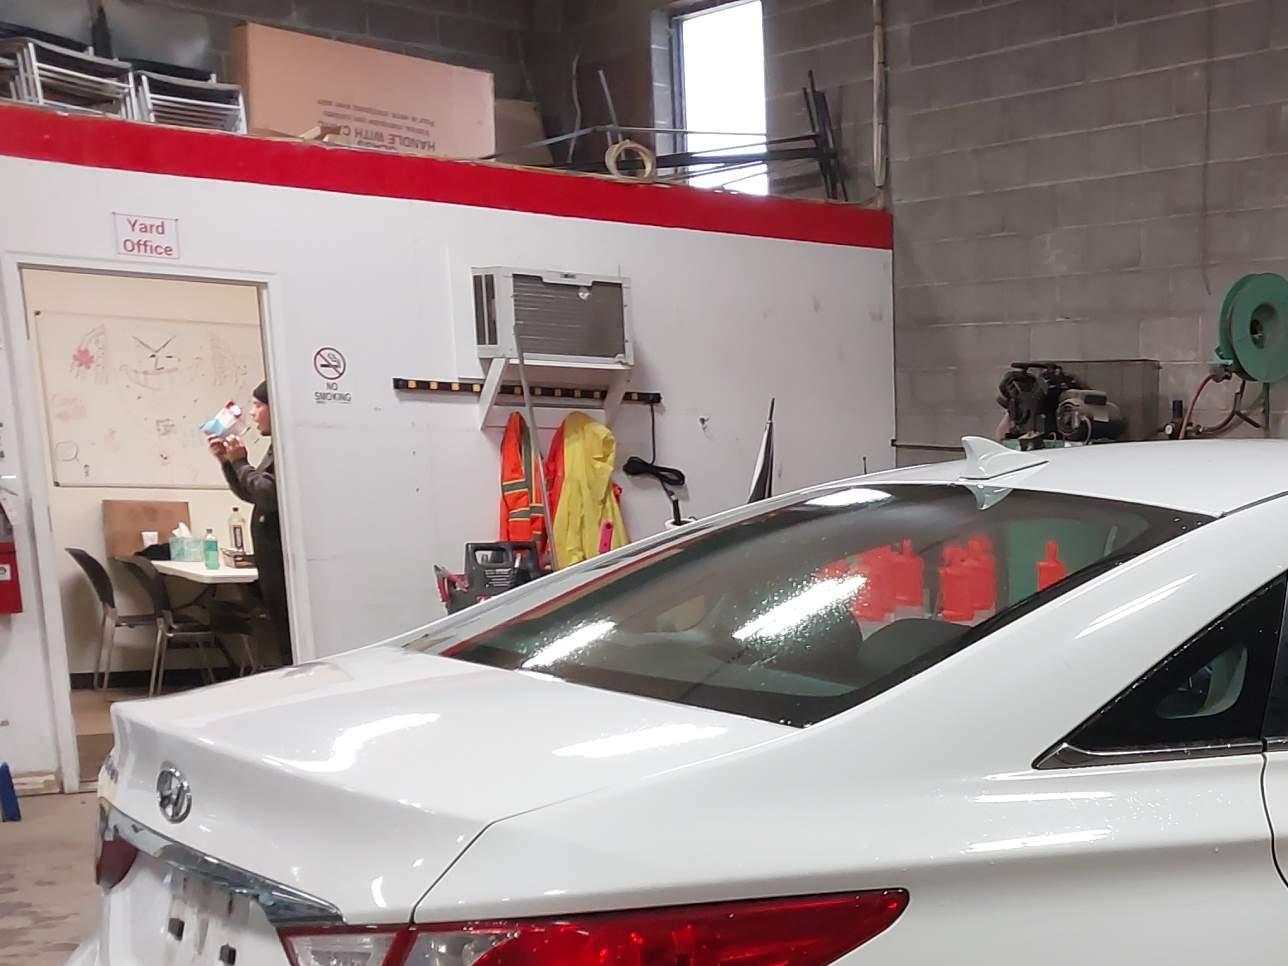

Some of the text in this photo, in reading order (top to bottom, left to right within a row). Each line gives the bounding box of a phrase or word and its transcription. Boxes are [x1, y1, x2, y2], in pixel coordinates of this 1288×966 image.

[354, 127, 385, 143] WITH
[388, 132, 436, 152] HANDLE
[127, 217, 165, 235] Yard
[123, 238, 173, 256] Office
[326, 382, 338, 391] NO
[314, 391, 352, 402] SMOKING
